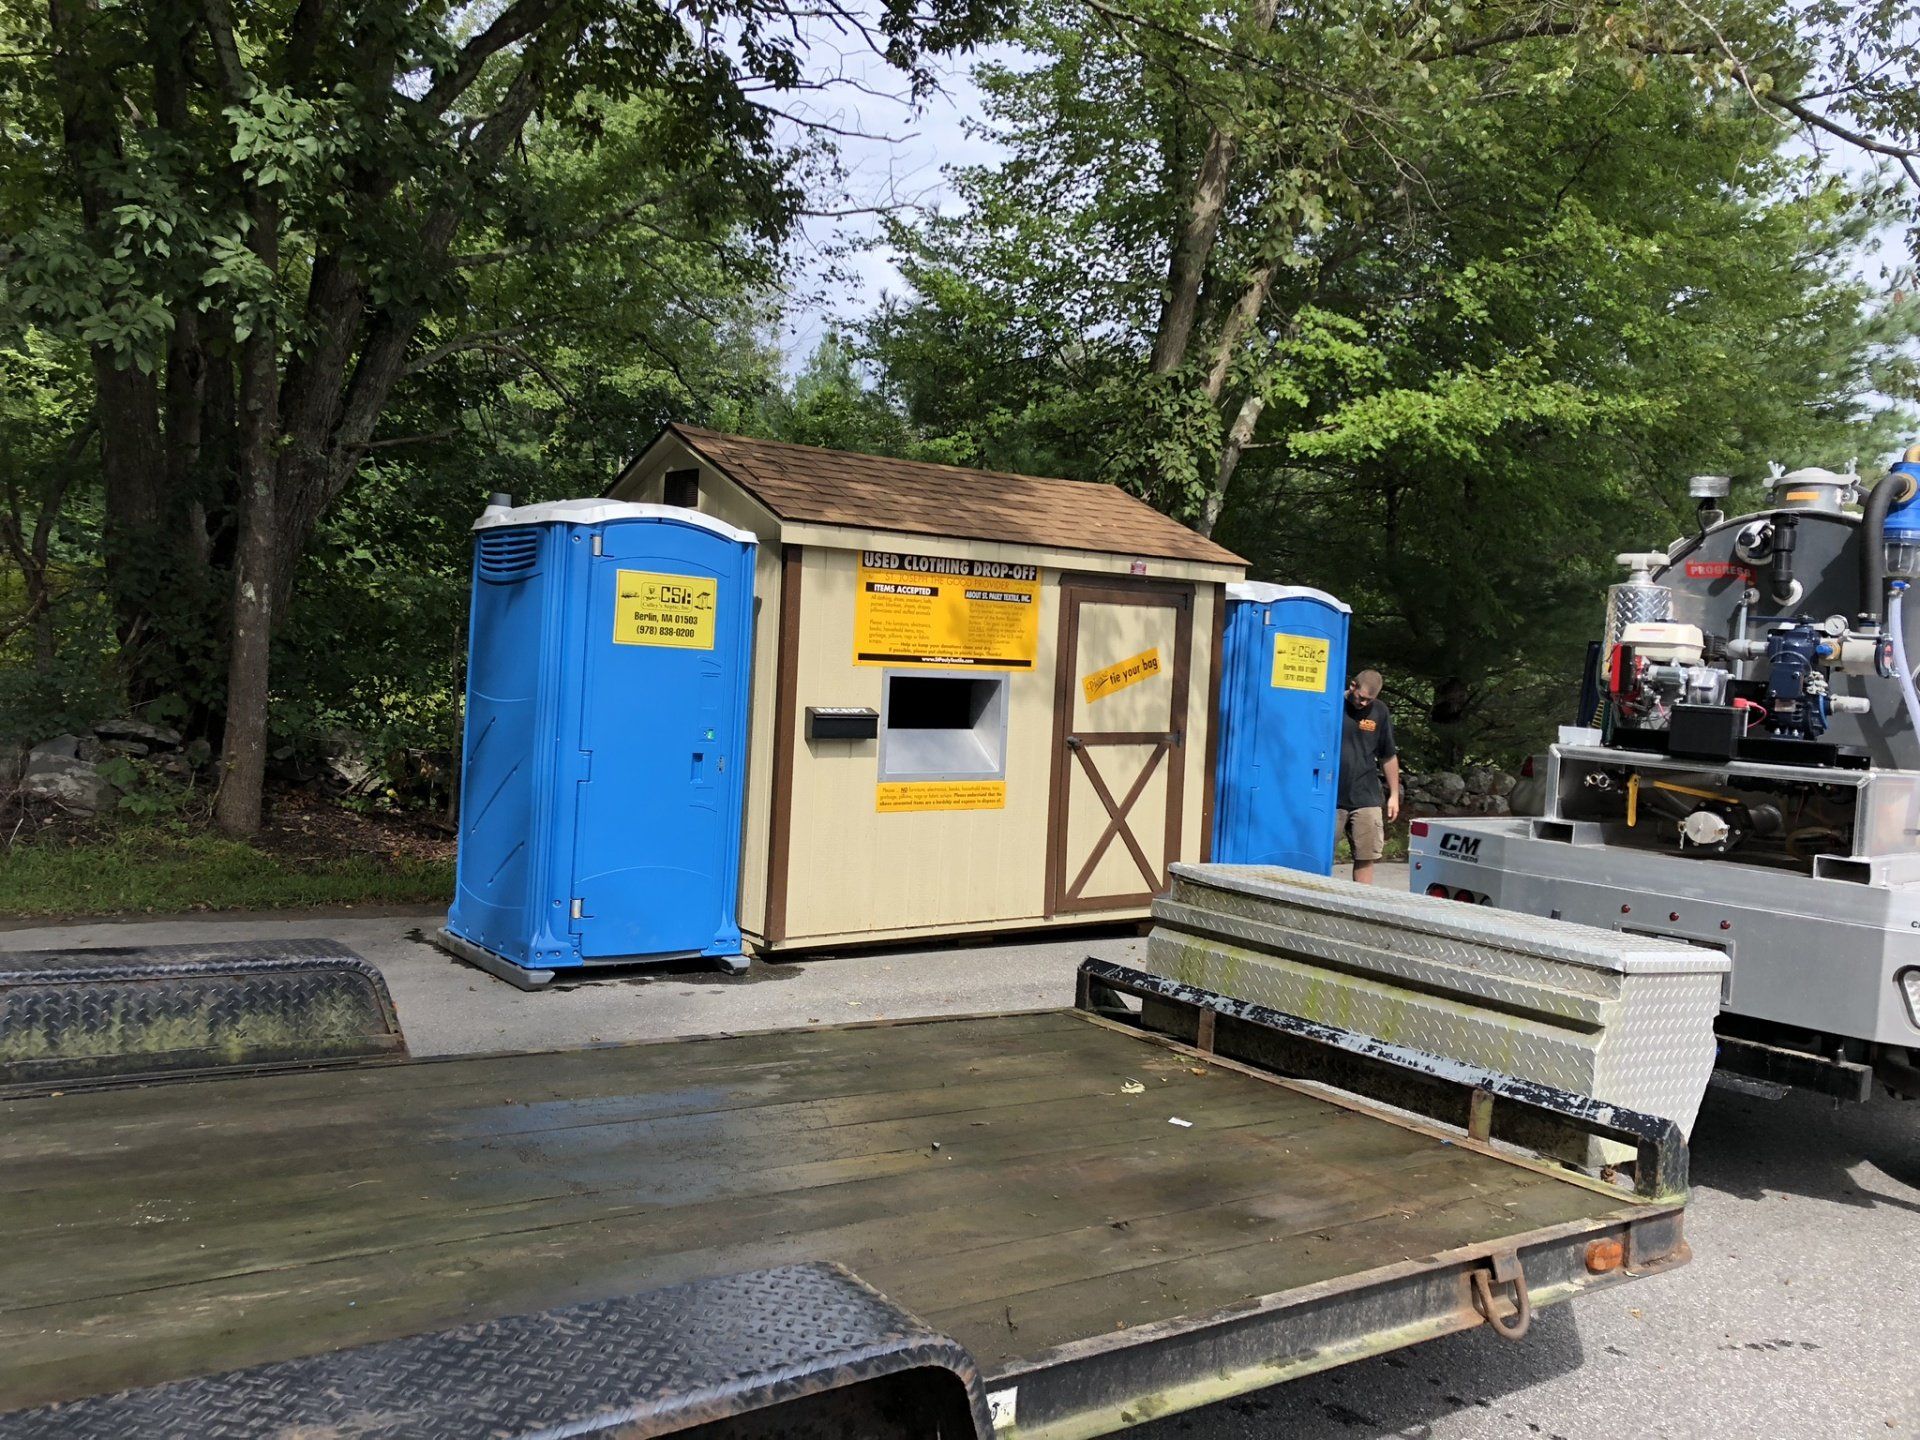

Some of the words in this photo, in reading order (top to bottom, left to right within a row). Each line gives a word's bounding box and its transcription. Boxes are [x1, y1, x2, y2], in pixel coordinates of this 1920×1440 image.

[864, 552, 899, 569] USED
[904, 556, 969, 575] CLOTHING
[974, 562, 1036, 580] DROP-OFF
[1691, 566, 1751, 577] PROGRESS
[898, 574, 928, 583] JOSEPH
[931, 576, 943, 584] THE
[946, 578, 971, 586] GOOD
[974, 579, 1010, 590] PROVIDER
[874, 584, 895, 592] ITEMS
[897, 586, 931, 595] ACCEPTED
[634, 612, 658, 623] Berlin,
[662, 614, 672, 623] MA
[675, 615, 698, 625] 01503
[637, 625, 657, 635] (978)
[660, 627, 694, 638] 838-0200
[1110, 672, 1120, 685] tie
[1123, 665, 1140, 683] your
[1142, 658, 1158, 671] bag
[1440, 833, 1482, 855] CM
